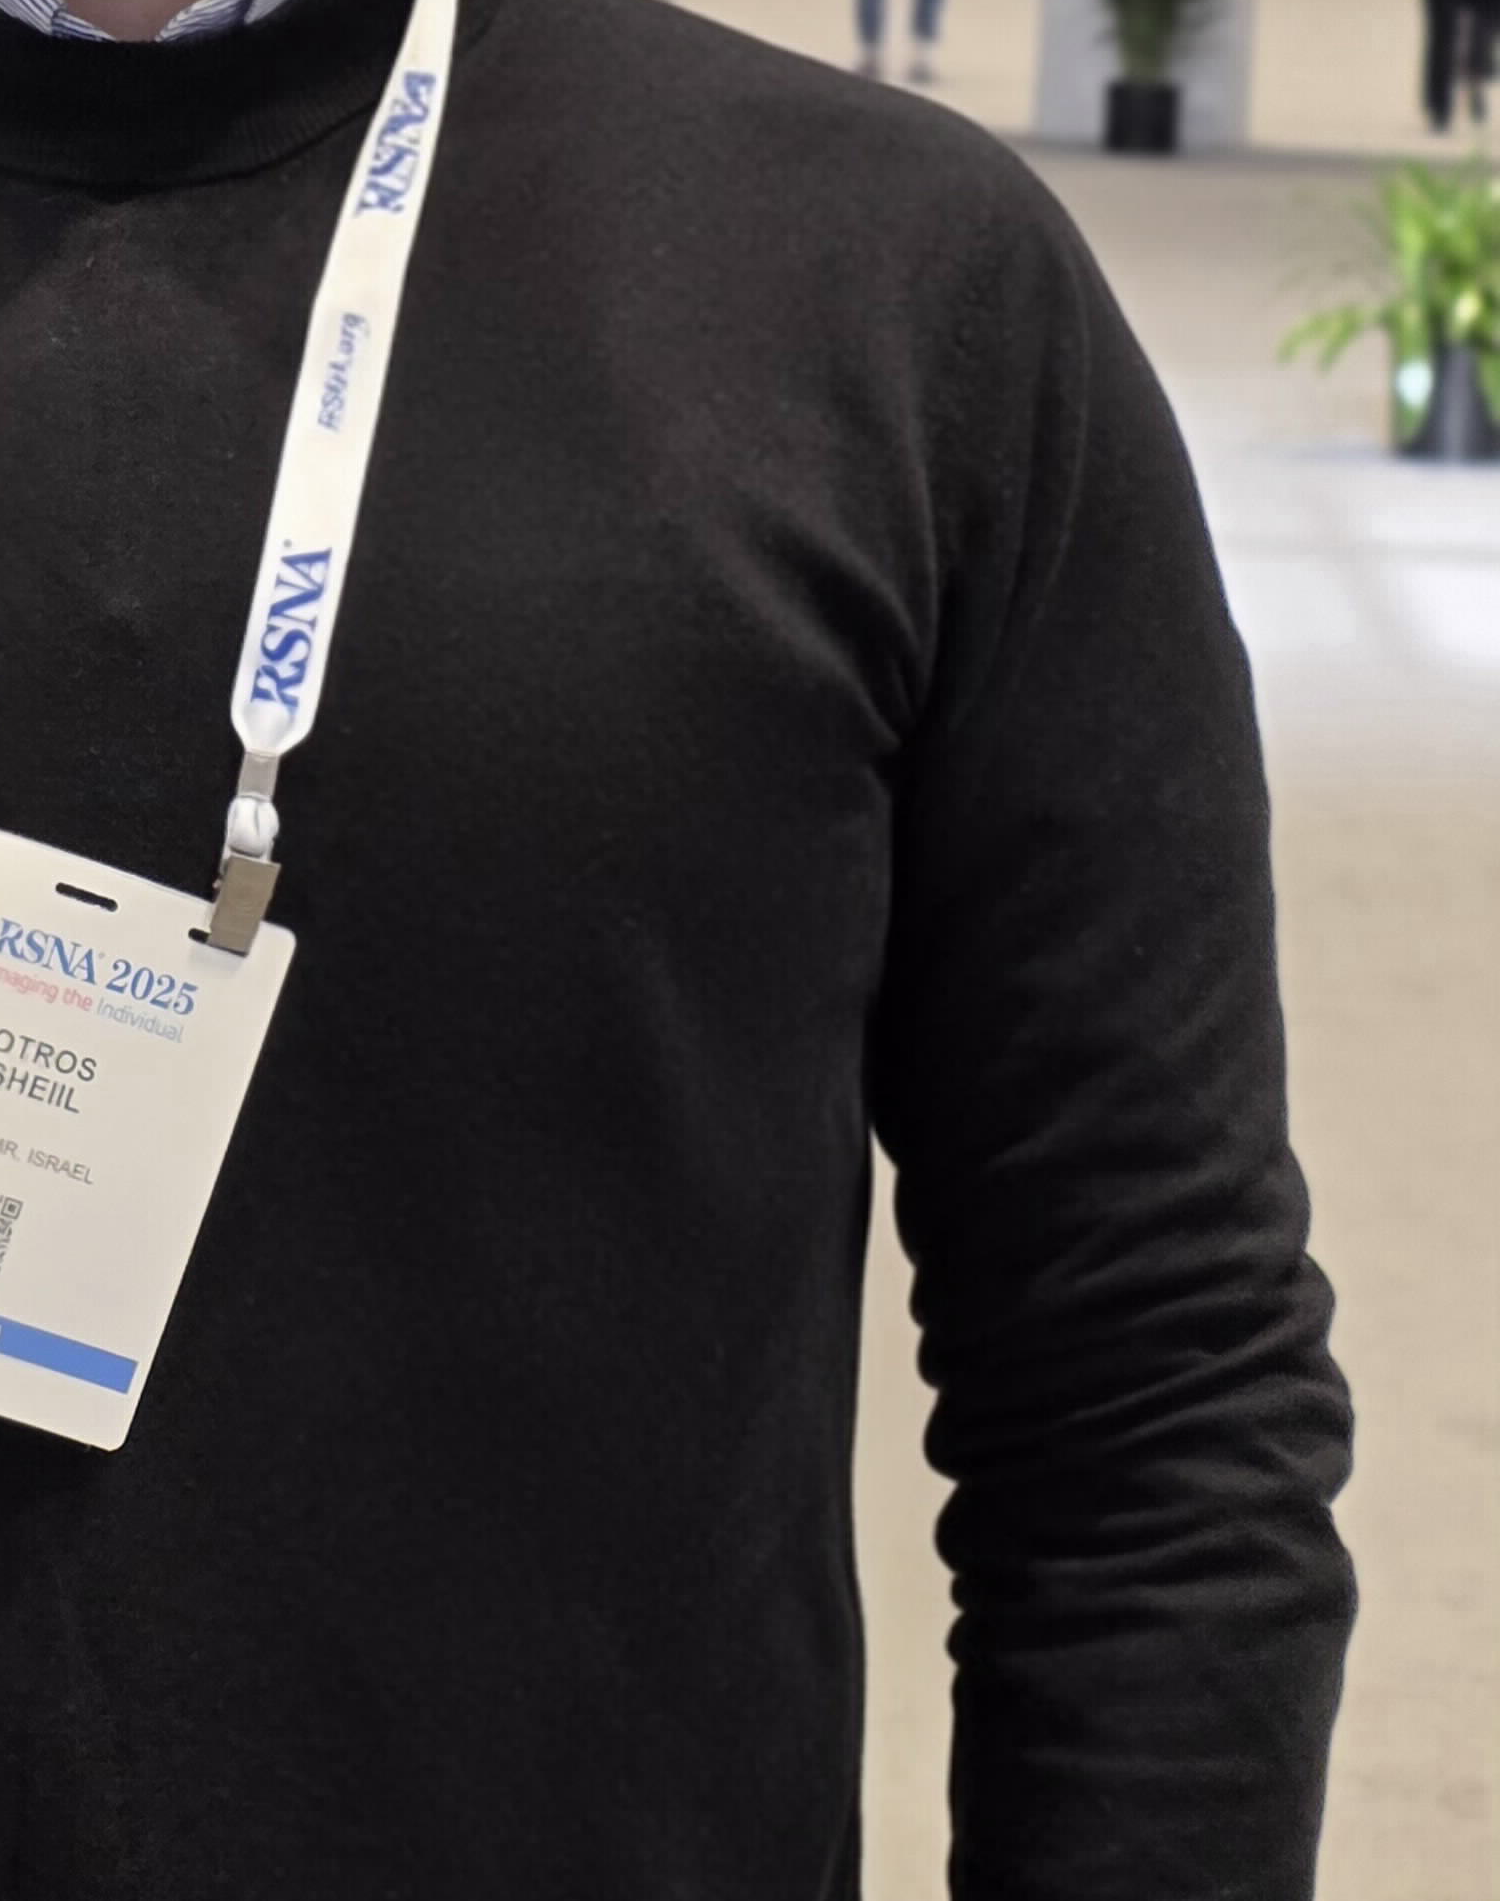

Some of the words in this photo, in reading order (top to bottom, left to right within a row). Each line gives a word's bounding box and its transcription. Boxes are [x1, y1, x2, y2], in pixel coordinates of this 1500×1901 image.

[250, 547, 332, 708] RSNA
[106, 958, 198, 1015] 2025
[62, 987, 93, 1011] the
[97, 998, 184, 1043] Individual
[27, 1148, 93, 1185] ISRAEL
